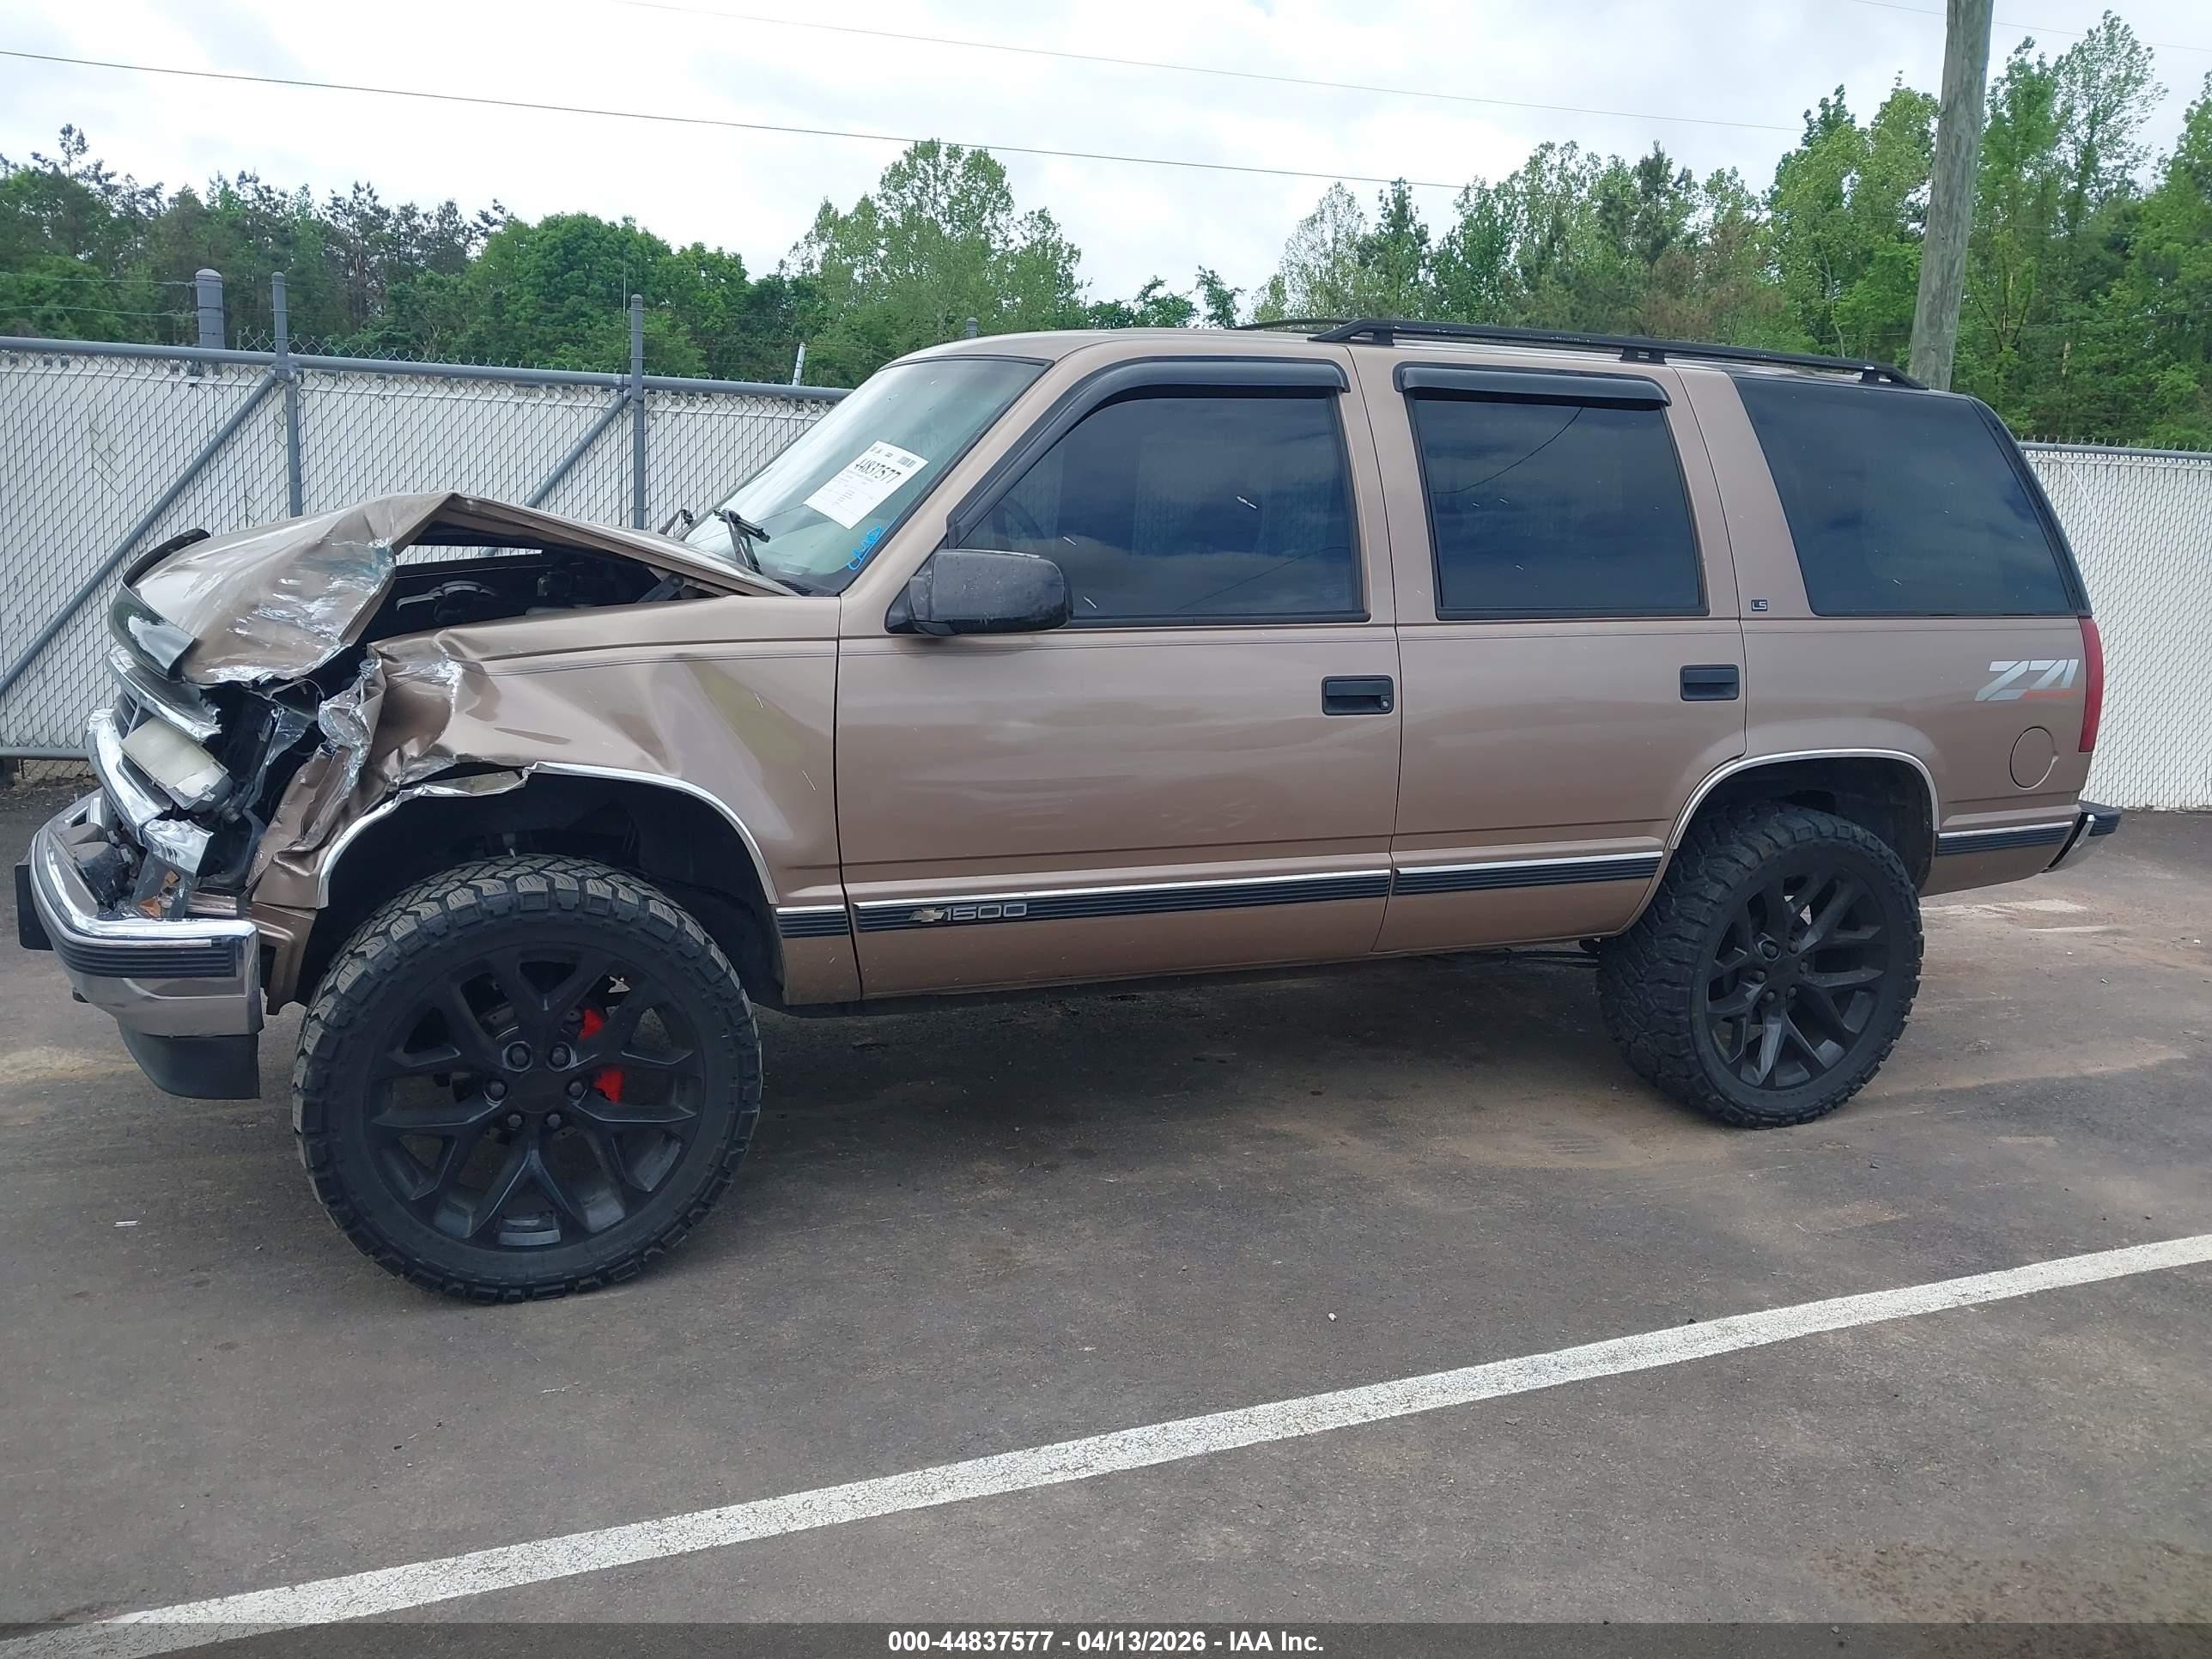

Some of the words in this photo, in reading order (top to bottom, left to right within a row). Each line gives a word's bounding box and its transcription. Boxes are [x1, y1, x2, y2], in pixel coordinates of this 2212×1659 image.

[854, 457, 902, 485] 44837577
[1752, 600, 1767, 610] LS
[1974, 659, 2080, 702] Z71
[944, 902, 1028, 922] 1500
